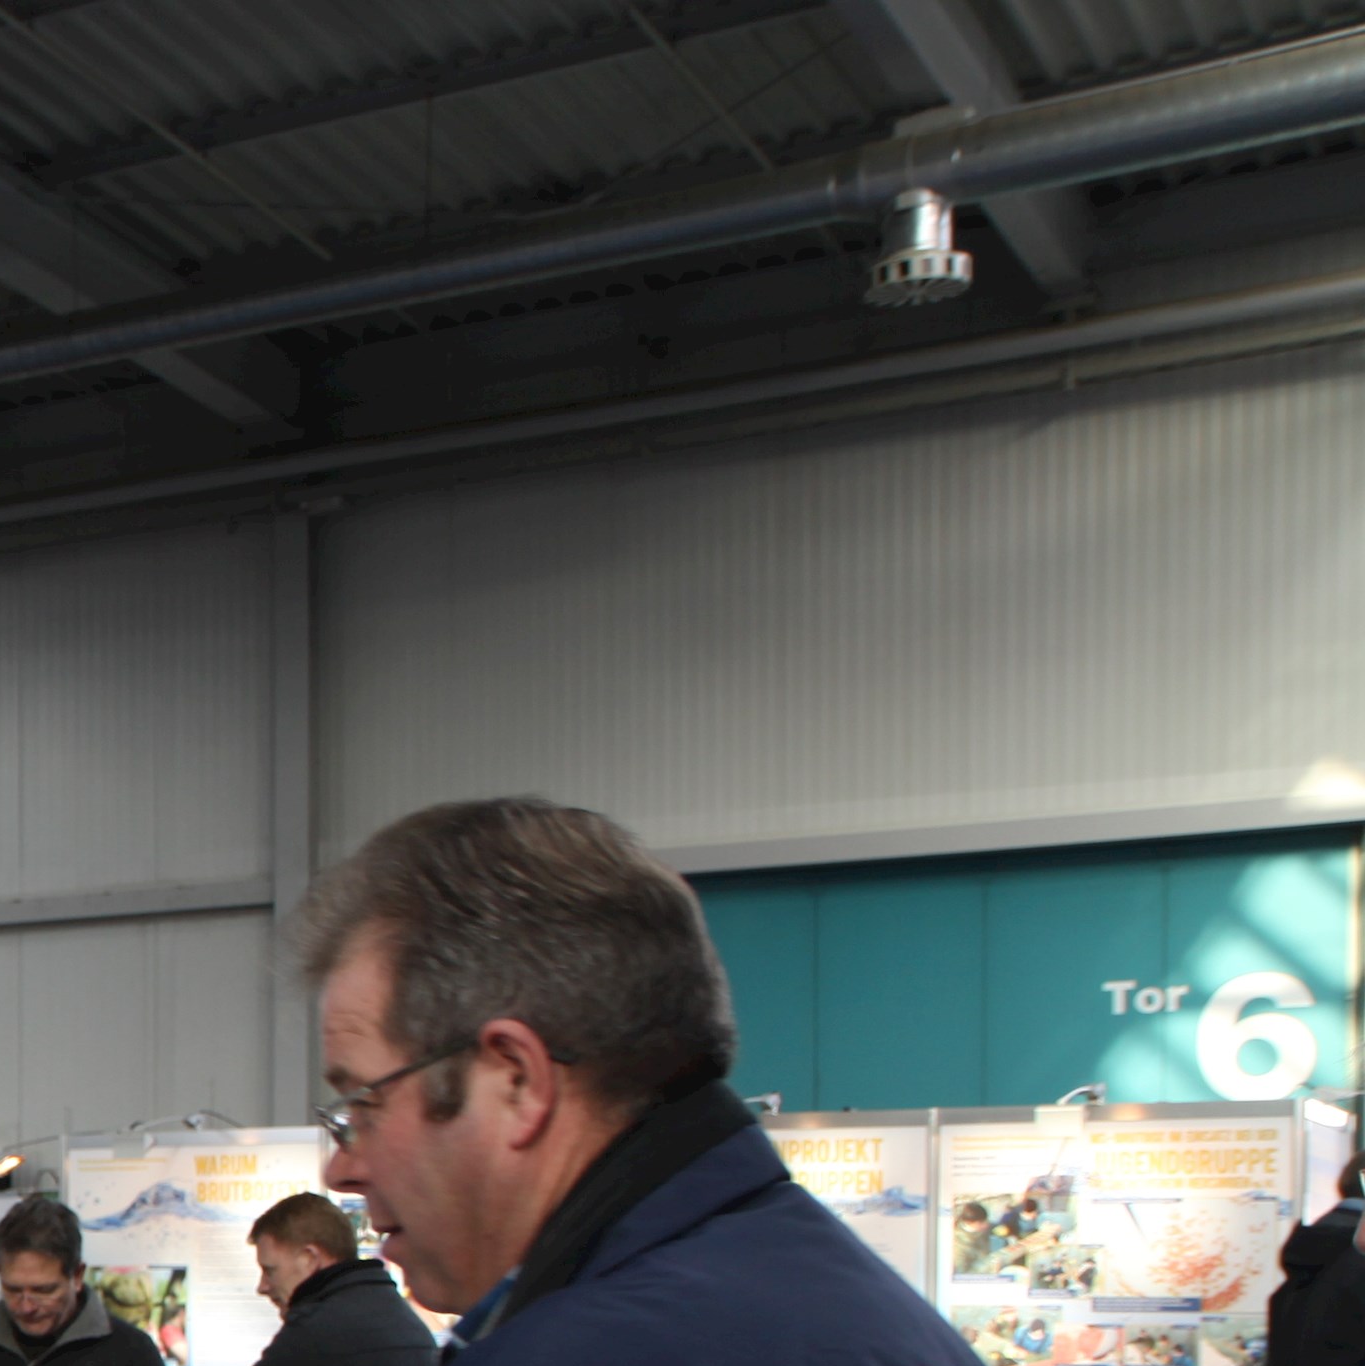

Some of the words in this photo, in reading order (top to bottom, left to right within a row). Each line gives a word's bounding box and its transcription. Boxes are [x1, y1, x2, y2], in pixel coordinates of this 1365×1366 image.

[1101, 979, 1190, 1015] Tor
[1195, 971, 1317, 1101] 6
[194, 1154, 258, 1176] WARUM
